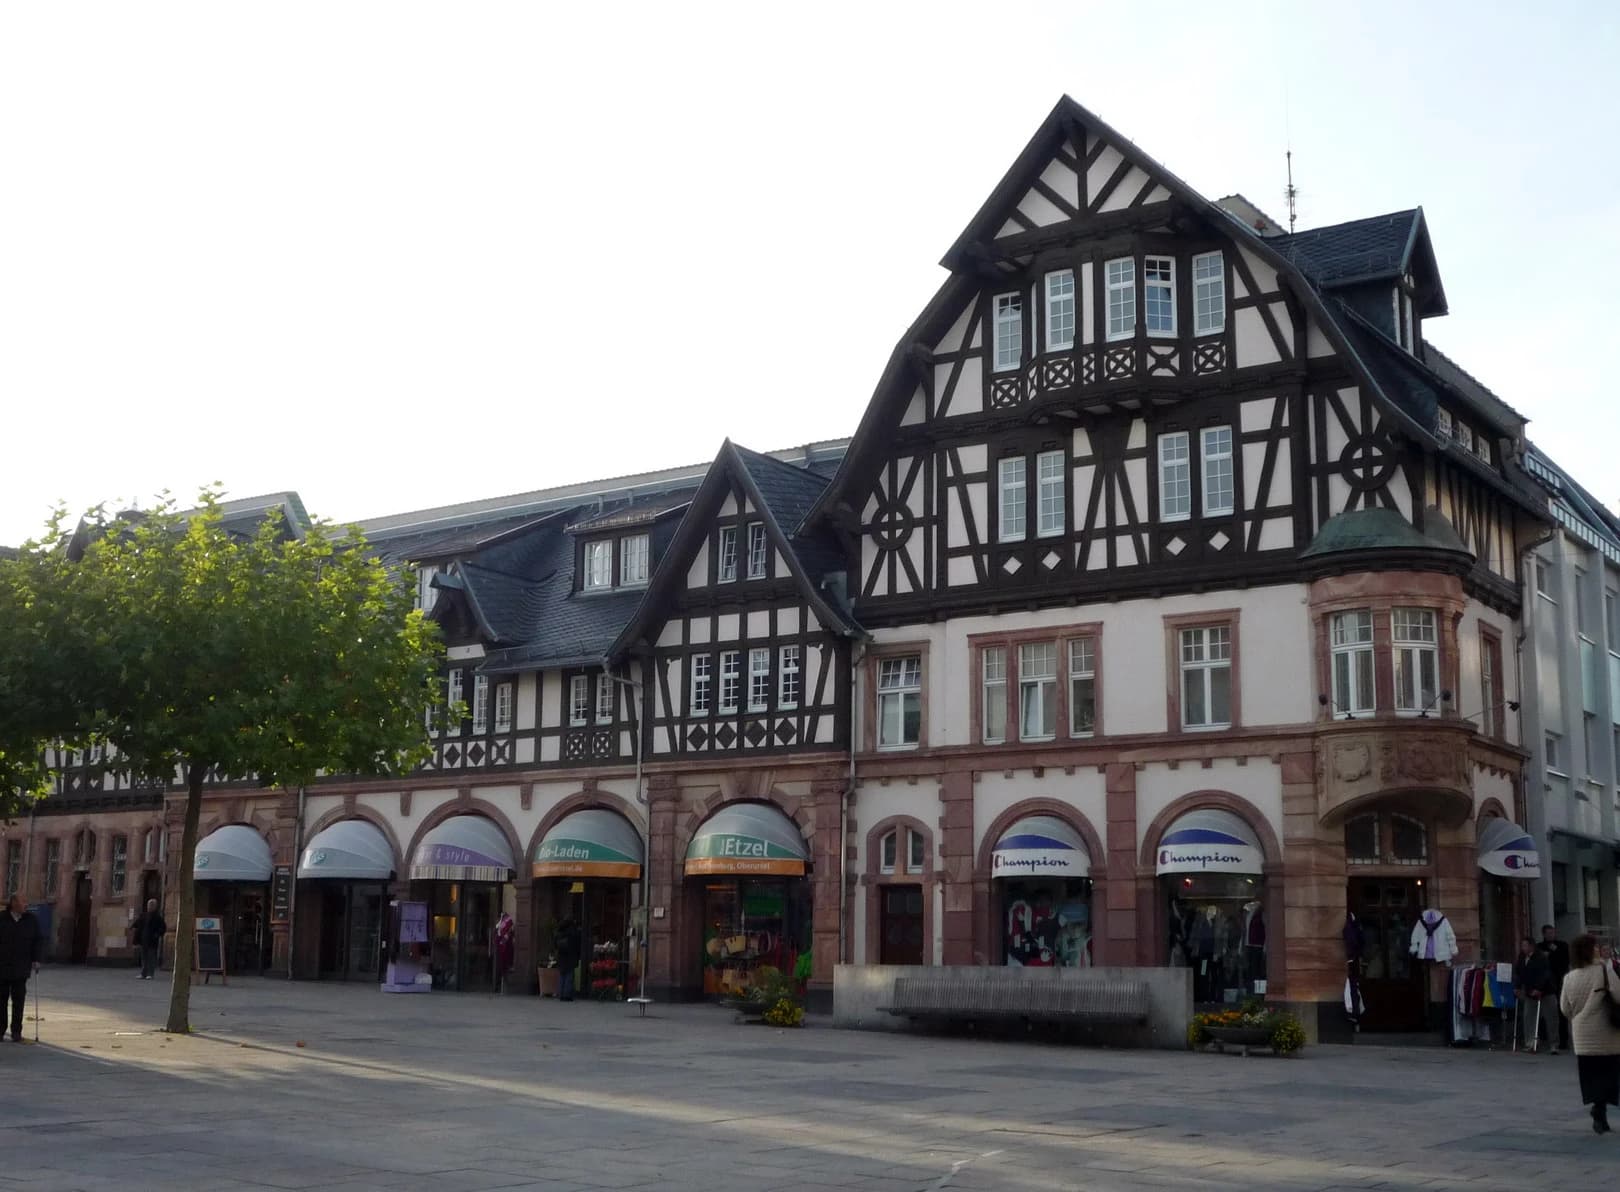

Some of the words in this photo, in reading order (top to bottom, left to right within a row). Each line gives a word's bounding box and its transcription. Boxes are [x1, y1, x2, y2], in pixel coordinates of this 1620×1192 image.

[725, 838, 768, 856] Etzel
[994, 855, 1071, 873] Champion
[1160, 850, 1244, 869] Champion
